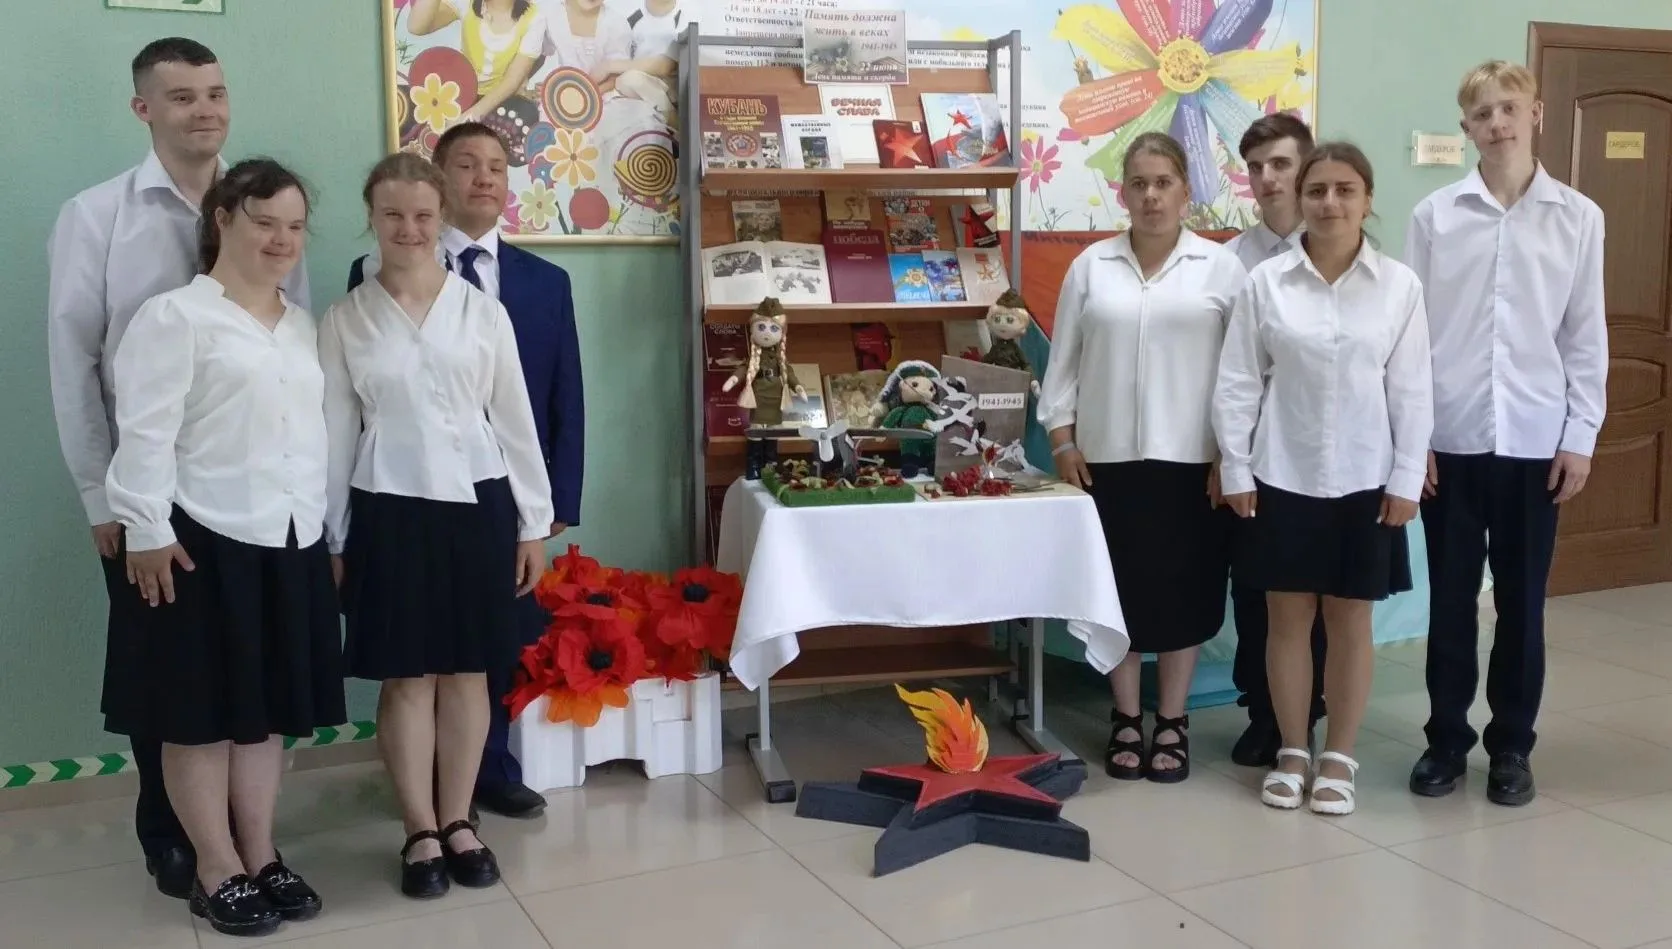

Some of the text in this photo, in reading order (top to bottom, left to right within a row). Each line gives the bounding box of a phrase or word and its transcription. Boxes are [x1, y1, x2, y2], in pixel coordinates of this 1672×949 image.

[724, 14, 794, 26] Ответственность
[804, 10, 850, 21] Память
[860, 29, 890, 37] веках
[707, 98, 768, 115] КУБАНЬ
[831, 98, 882, 107] ВЕЧНАЯ
[837, 107, 880, 116] СЛАВА
